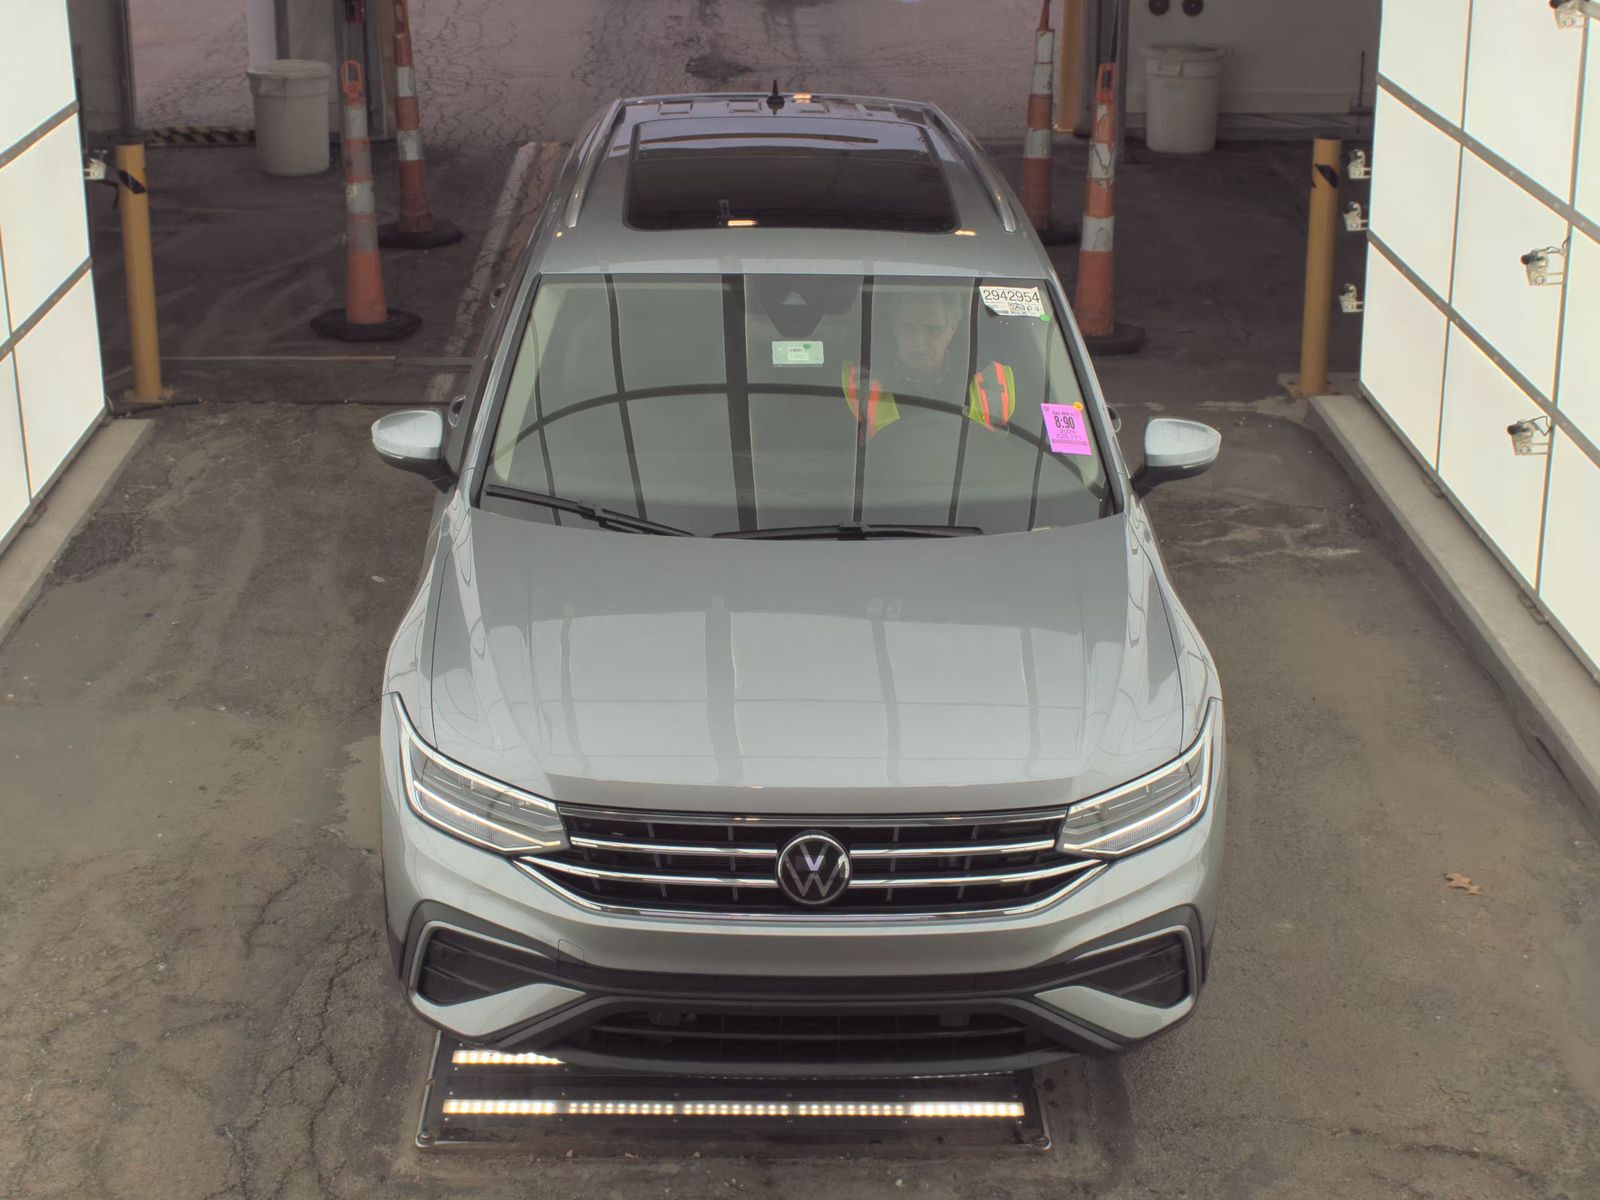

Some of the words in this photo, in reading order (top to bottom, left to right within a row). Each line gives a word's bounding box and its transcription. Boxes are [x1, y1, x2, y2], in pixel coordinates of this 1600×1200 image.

[983, 289, 1040, 303] 2942954
[1054, 415, 1075, 430] 8:90
[784, 842, 845, 898] VW
